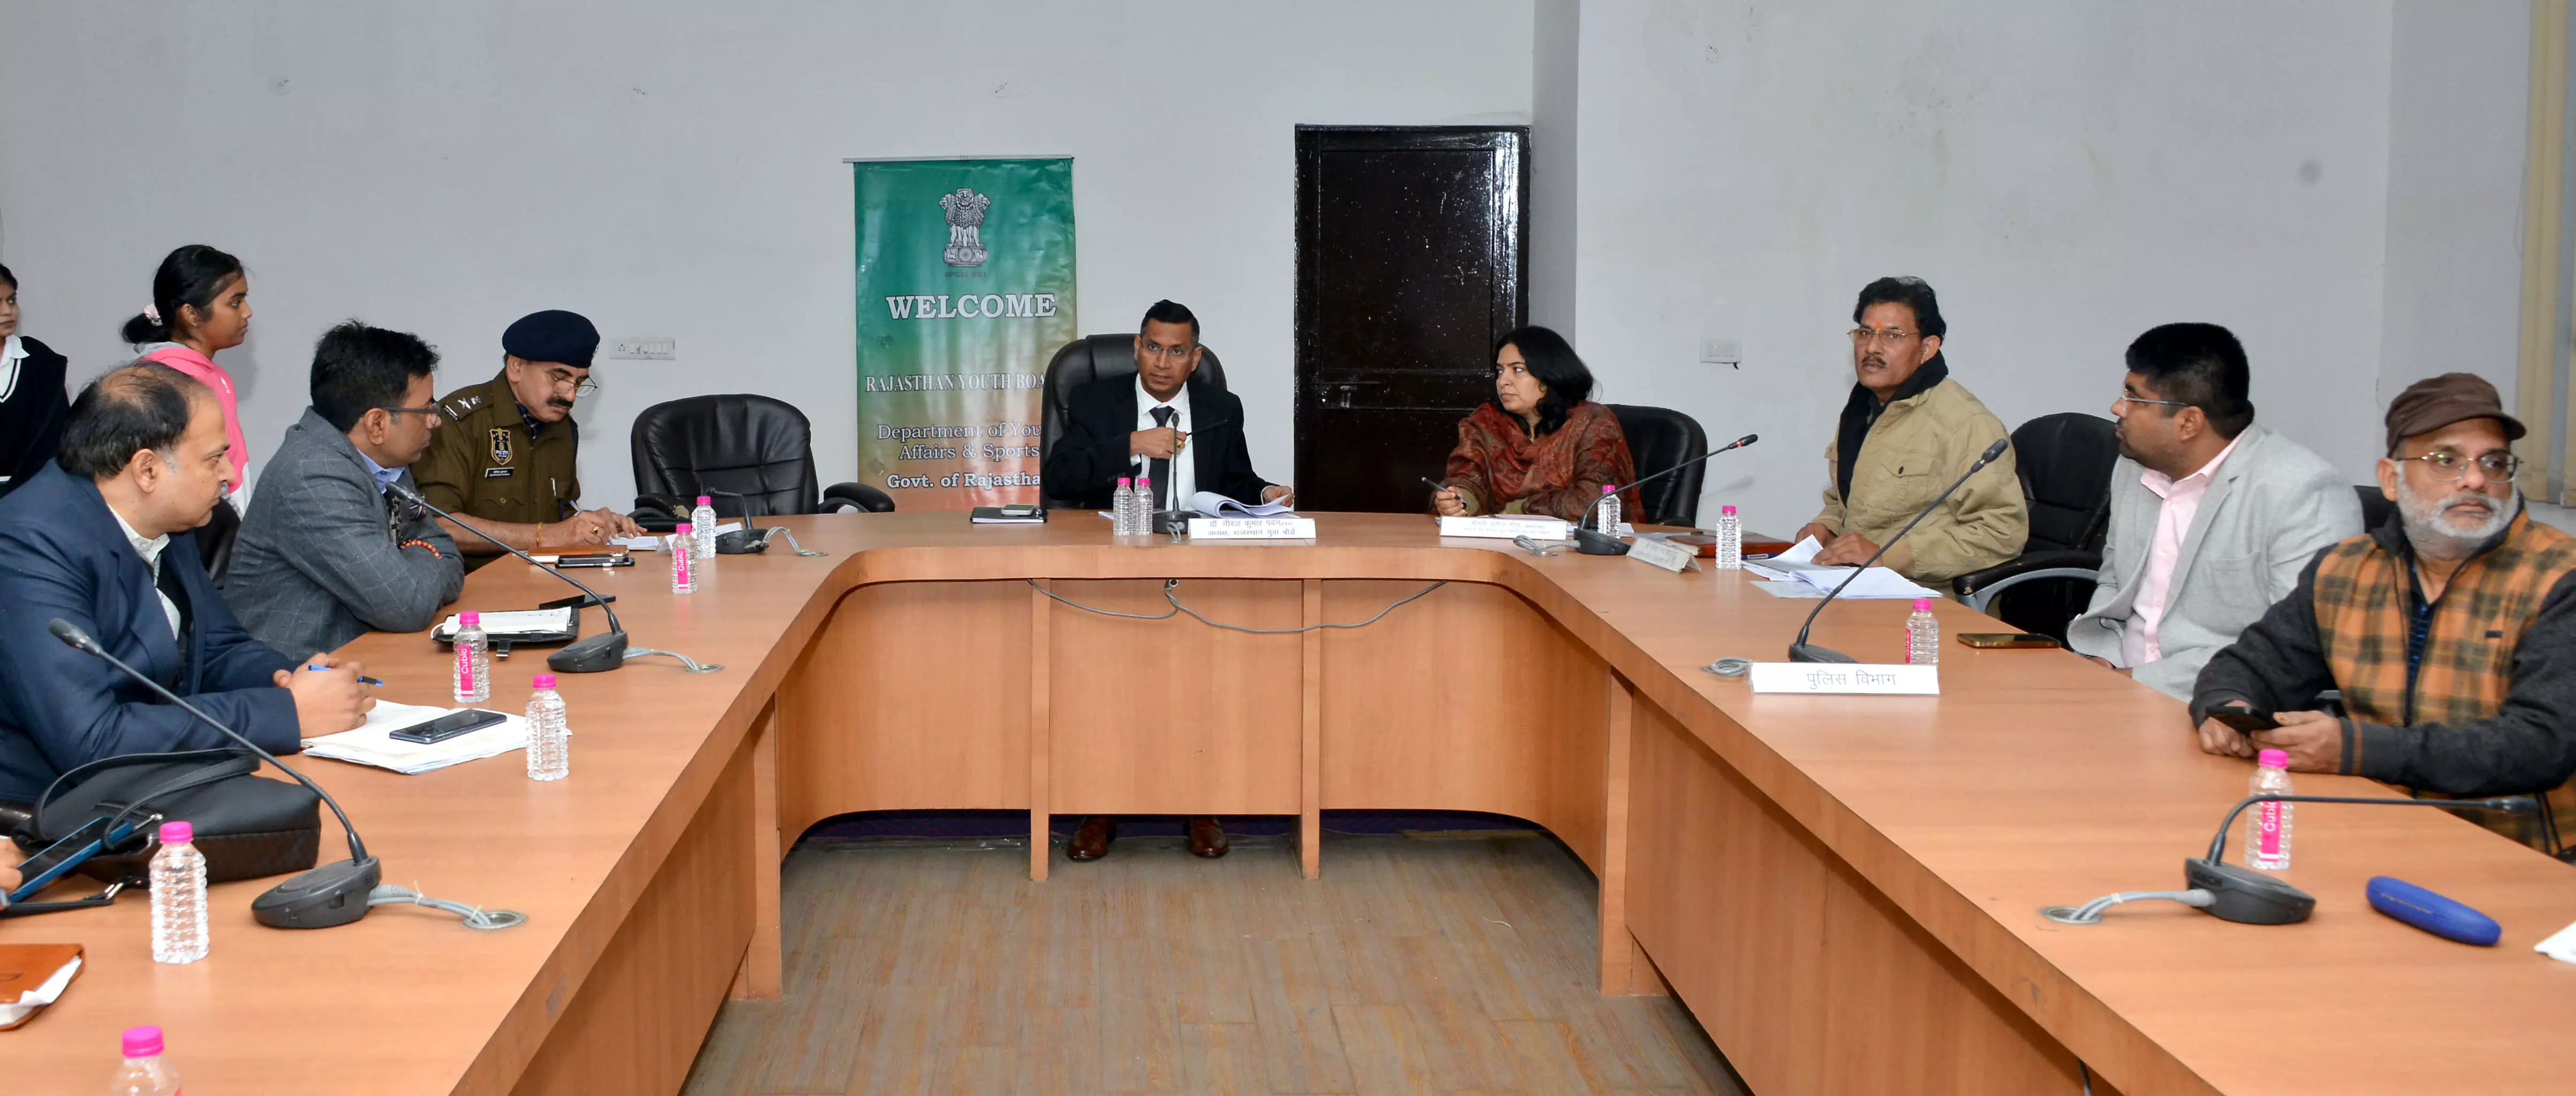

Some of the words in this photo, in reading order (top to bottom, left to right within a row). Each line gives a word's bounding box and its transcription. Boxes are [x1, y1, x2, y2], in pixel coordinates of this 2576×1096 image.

[886, 293, 1057, 319] WELCOME
[866, 375, 954, 392] RAJASTHAN
[958, 374, 1011, 390] YOUTH
[1015, 372, 1044, 390] BOA
[877, 424, 983, 443] Department
[988, 421, 1007, 438] of
[1009, 422, 1041, 437] You
[899, 444, 957, 460] Affairs
[961, 443, 976, 459] &
[983, 443, 1040, 461] Sports
[887, 474, 935, 488] Govt.
[940, 473, 960, 488] of
[964, 471, 1041, 491] Rajastha
[1244, 520, 1262, 528] कुमार
[1807, 669, 1846, 689] पुलिस
[1855, 669, 1896, 685] विभाग
